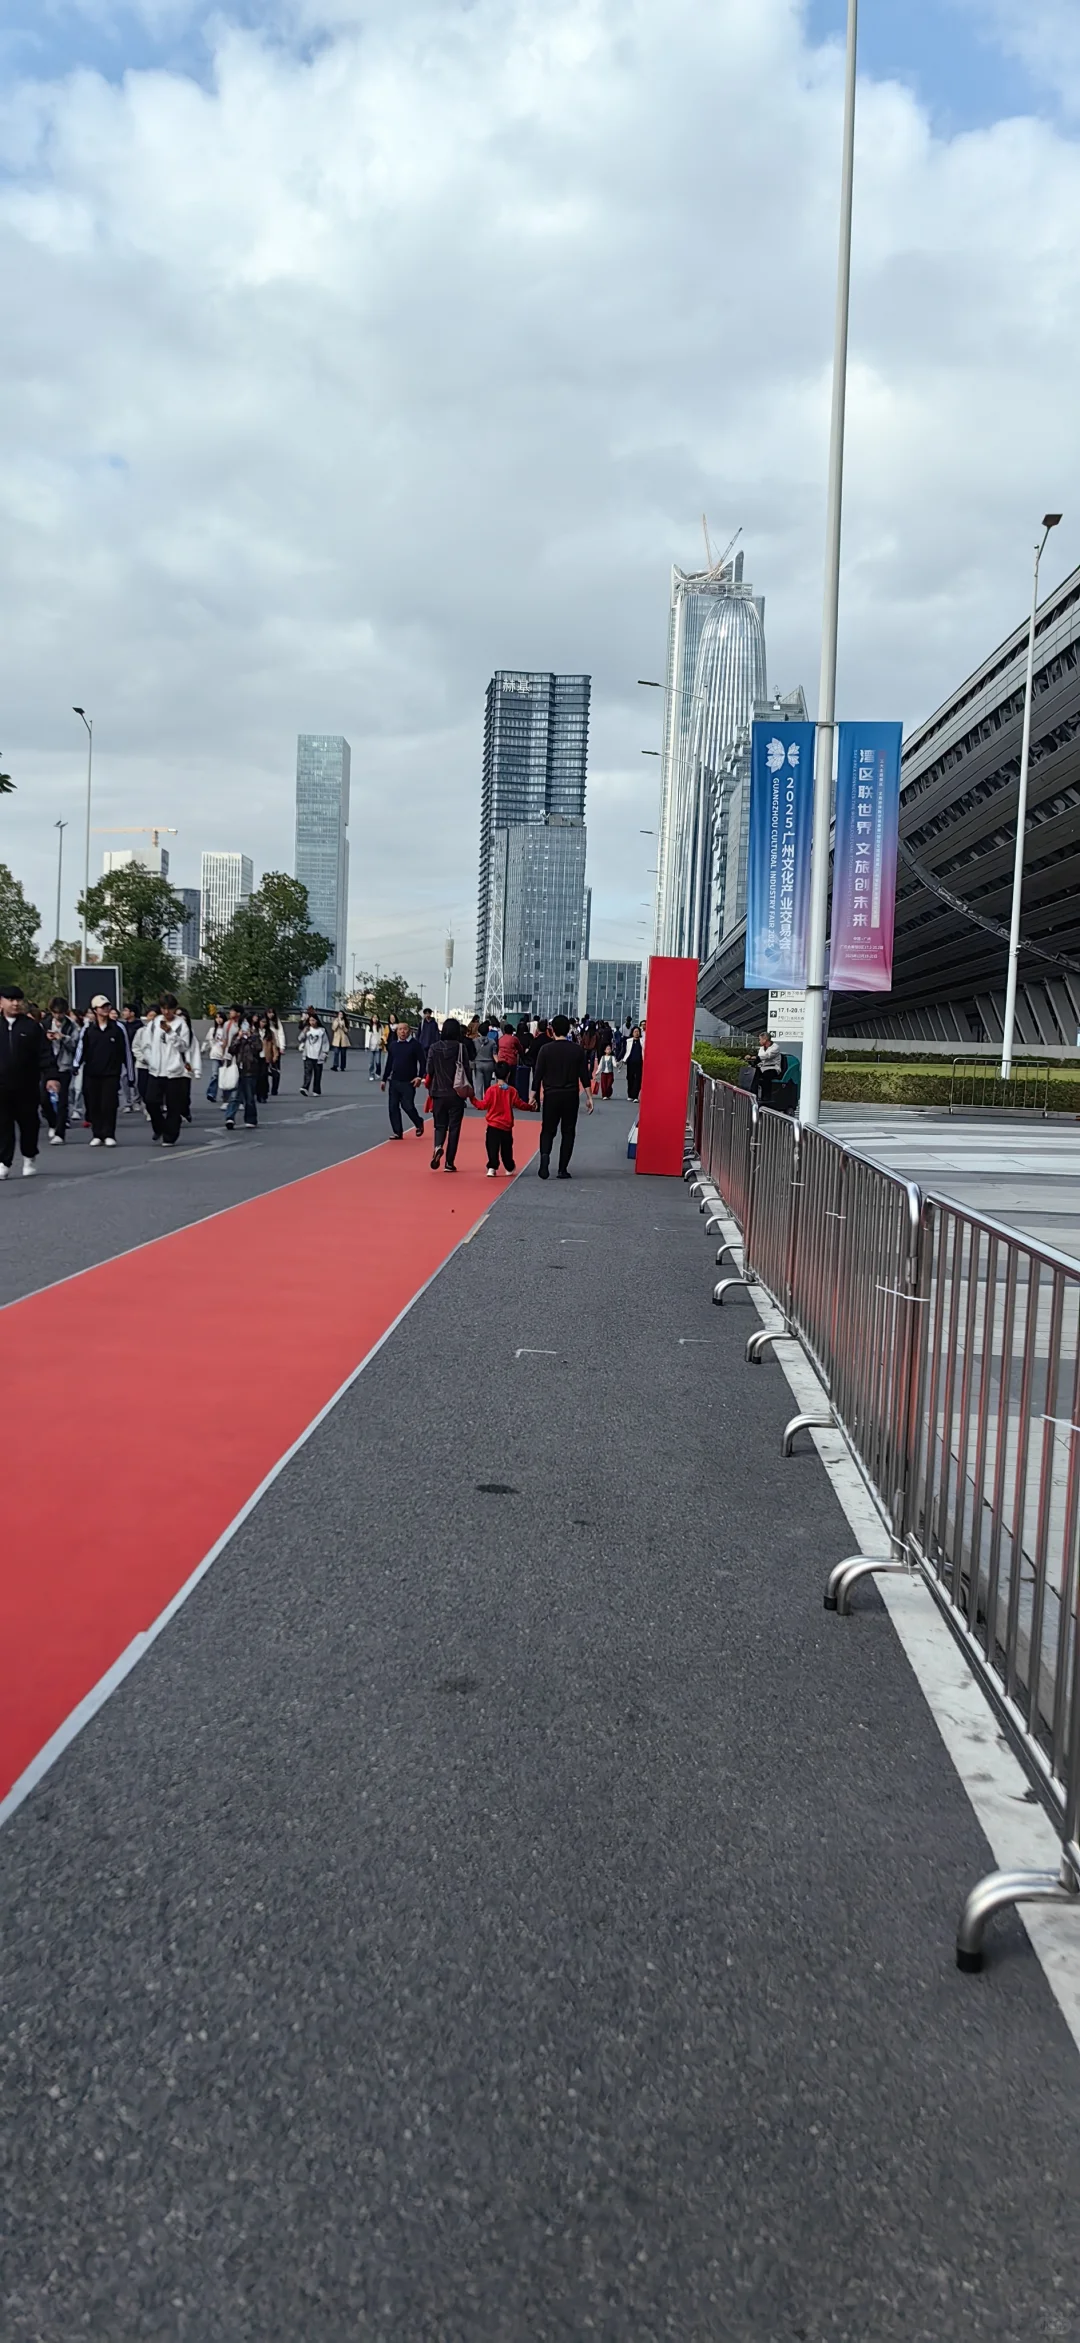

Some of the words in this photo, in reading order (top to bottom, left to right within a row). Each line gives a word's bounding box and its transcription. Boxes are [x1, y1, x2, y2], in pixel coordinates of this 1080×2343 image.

[502, 678, 530, 694] 赫基
[772, 777, 780, 828] GUANGZHOU
[856, 749, 875, 835] 湾区联世界
[770, 831, 778, 869] CULTURAL
[779, 777, 795, 950] 2025广州文化产业交易会
[768, 871, 777, 910] INDUSTRY
[852, 842, 871, 927] 文旅创未来
[767, 929, 775, 948] 2025
[768, 911, 776, 928] FAIR
